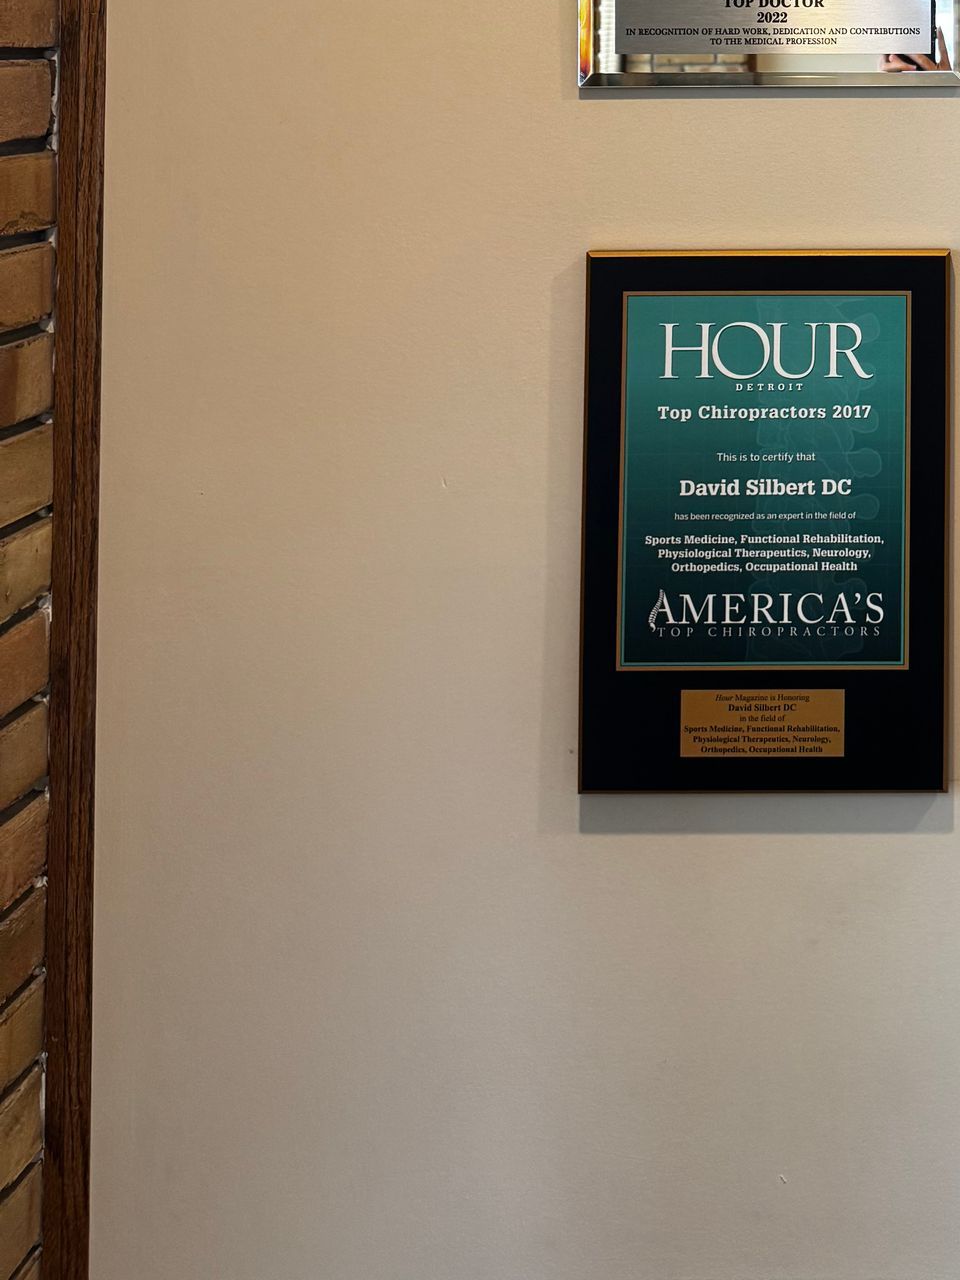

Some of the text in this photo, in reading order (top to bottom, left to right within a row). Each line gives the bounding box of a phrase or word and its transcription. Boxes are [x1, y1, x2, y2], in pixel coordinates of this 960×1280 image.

[757, 11, 788, 24] 2022
[626, 28, 920, 36] IN RECOGNITION OF HARD WORK, DEDICATION AND CONTRIBUTIONS
[659, 322, 874, 380] HOUR
[736, 383, 804, 391] DETROIT
[658, 405, 872, 422] Top Chiropractors 2017
[717, 452, 816, 463] This is to certify that
[679, 479, 852, 496] David Silbert DC
[674, 512, 688, 520] has
[691, 512, 709, 520] been
[712, 512, 754, 522] recognized
[779, 512, 803, 521] expert
[806, 511, 812, 519] in
[815, 511, 827, 519] the
[830, 511, 846, 519] field
[848, 511, 856, 519] of
[645, 534, 884, 546] Sports Medicine, Functional Rehabilitation,
[658, 548, 871, 560] Physiological Therapeutics, Neurology,
[672, 561, 858, 573] Orthopedics, Occupational Health
[648, 590, 884, 628] AMERICA'S
[657, 626, 880, 637] TOP CHIROPRACTORS
